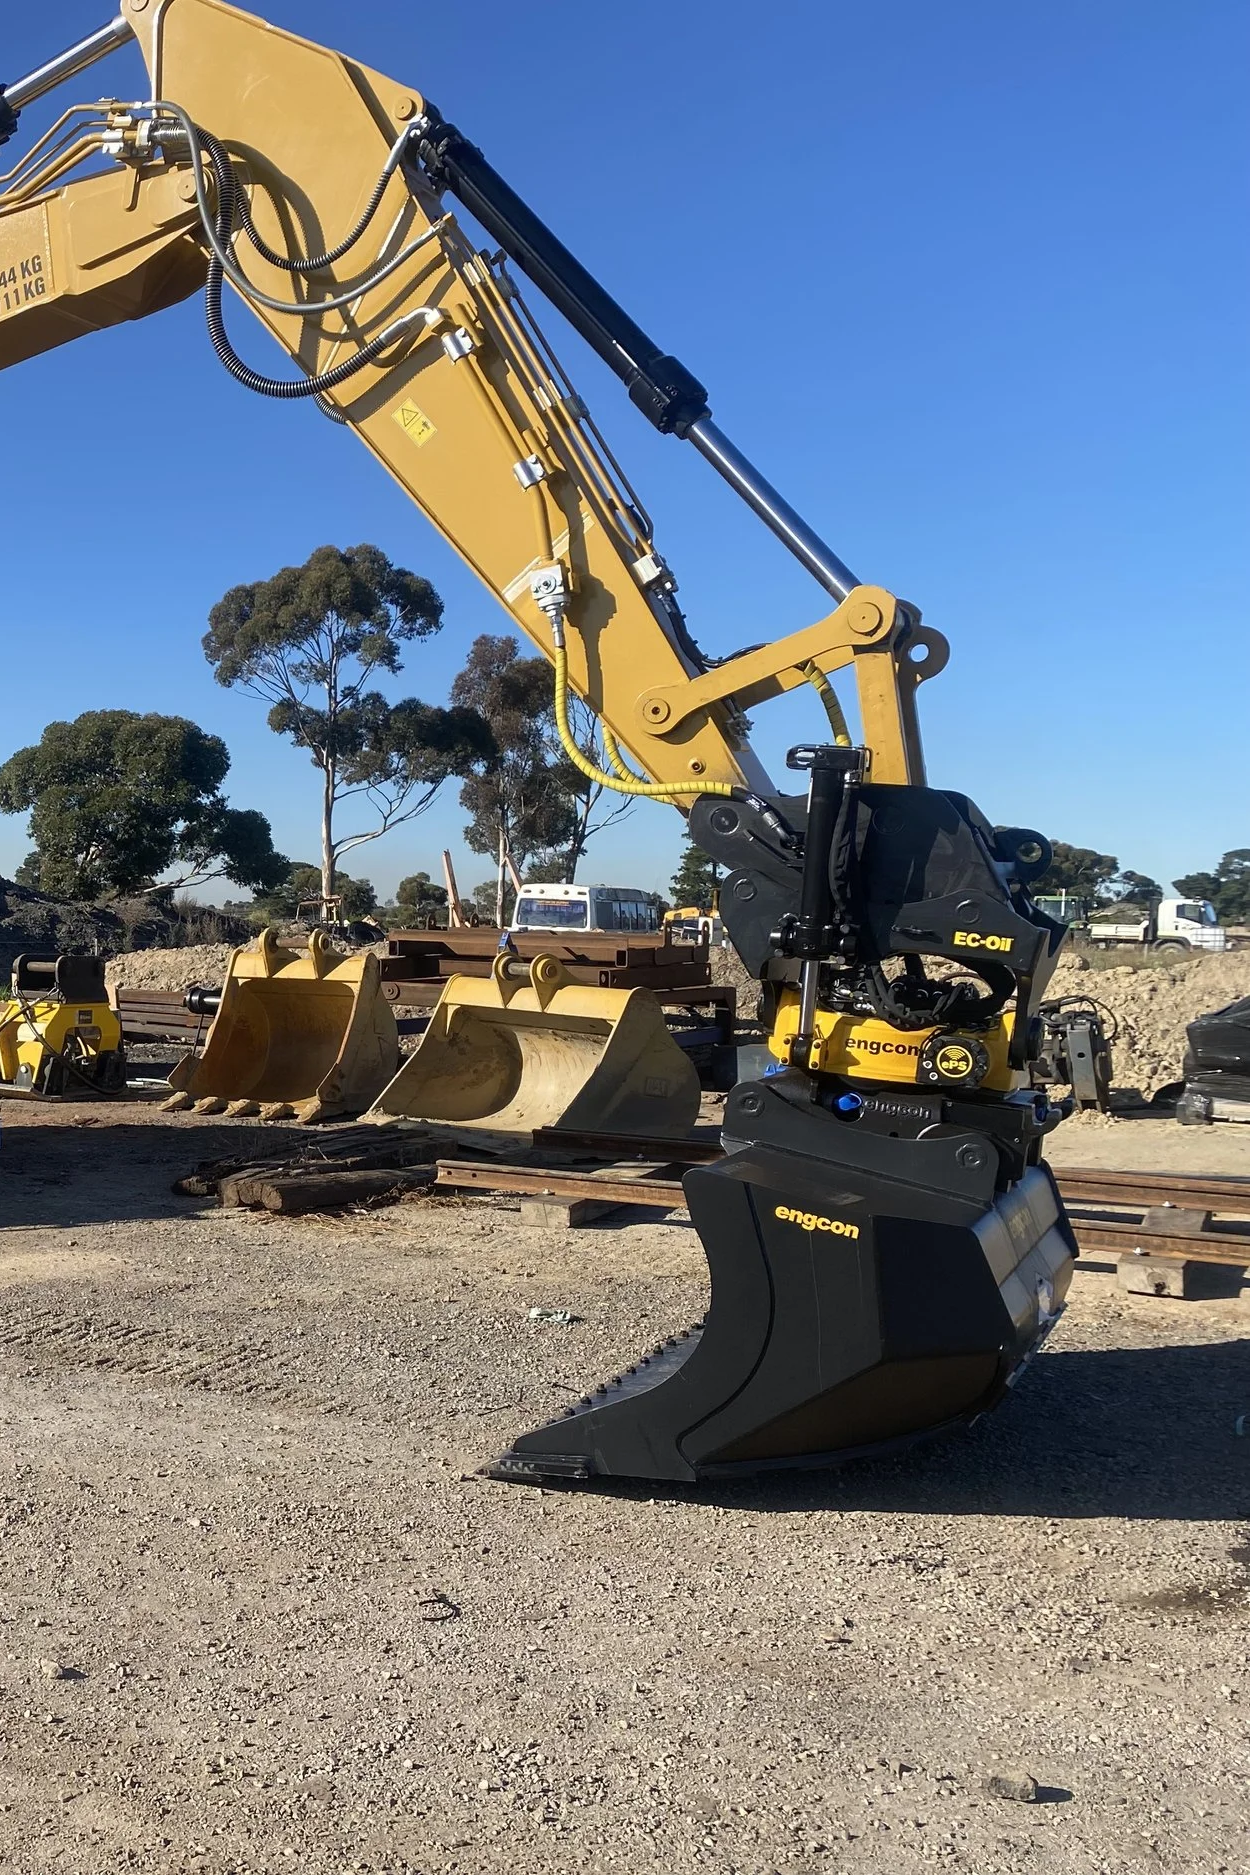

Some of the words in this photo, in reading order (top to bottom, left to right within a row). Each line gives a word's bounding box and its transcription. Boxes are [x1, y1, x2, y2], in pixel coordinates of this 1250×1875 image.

[20, 254, 43, 280] KG
[23, 276, 46, 301] KG
[953, 931, 1015, 952] EC-Oil
[845, 1037, 920, 1057] engcon
[941, 1060, 968, 1071] ePS
[775, 1205, 860, 1240] engcon
